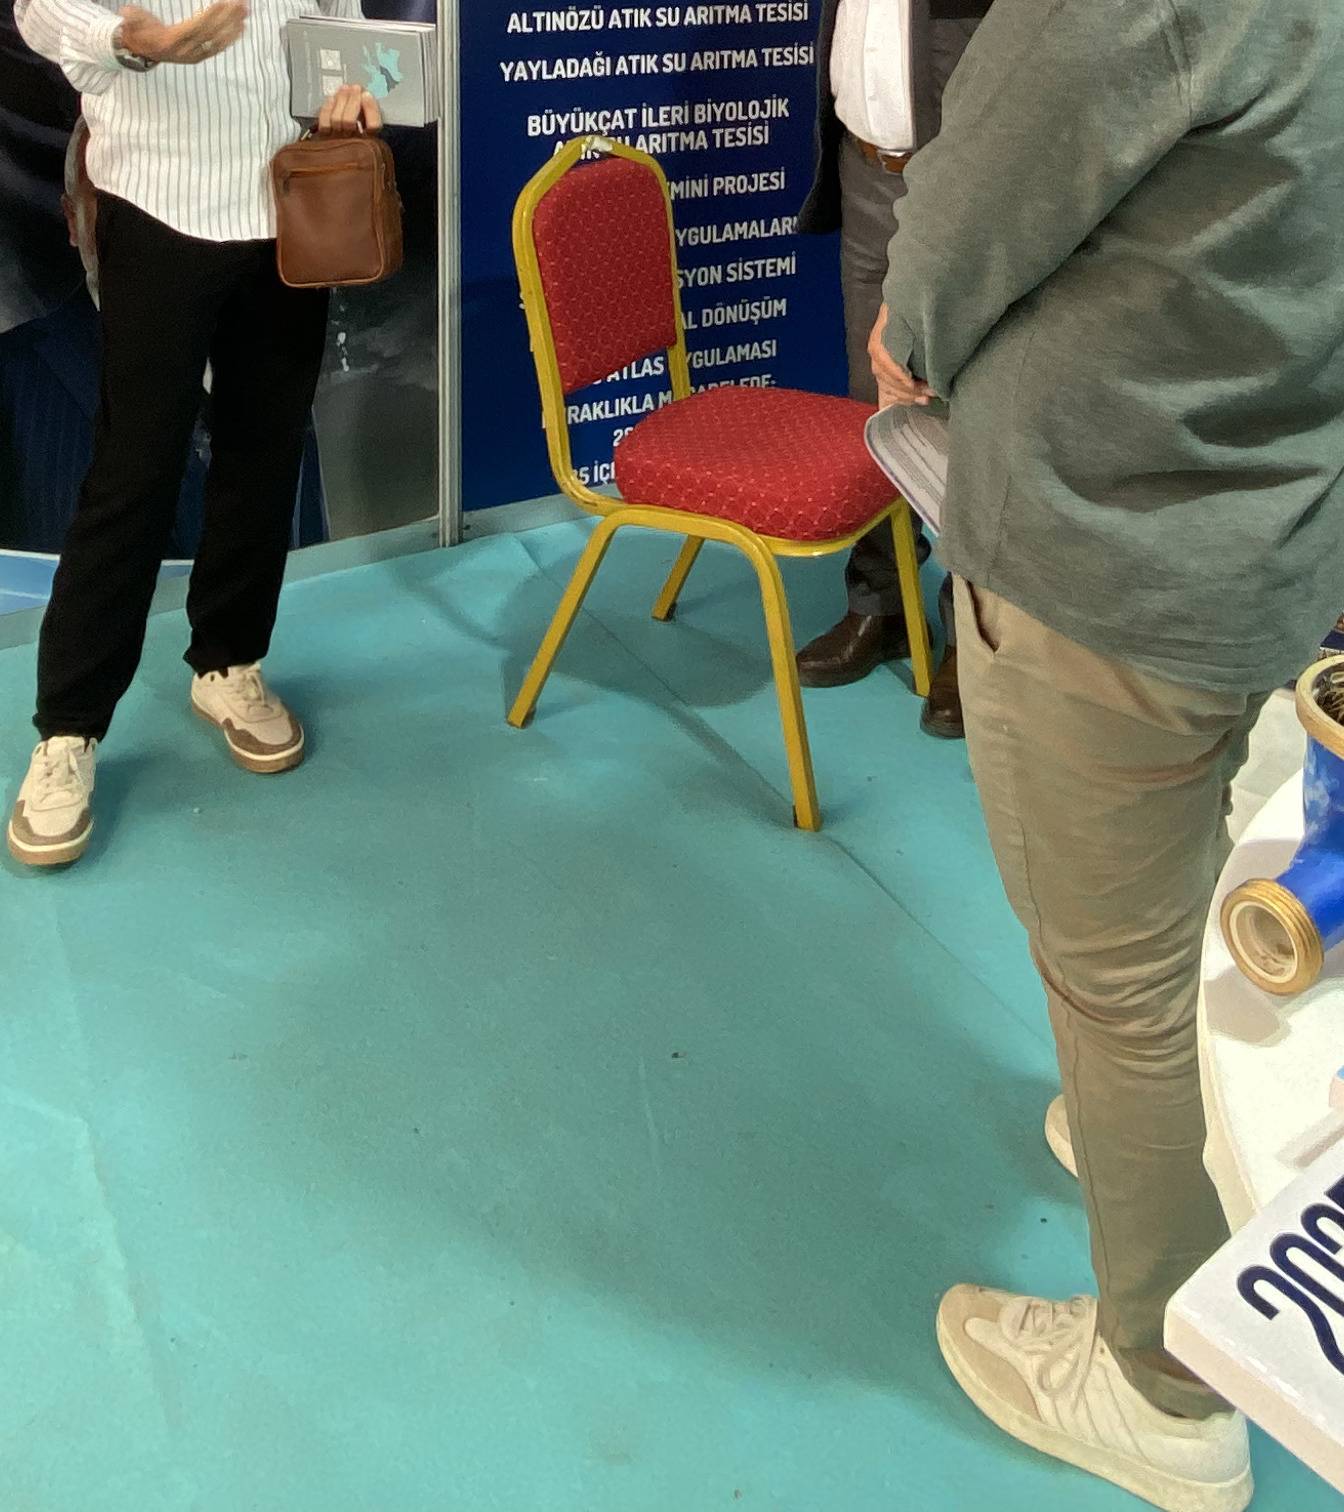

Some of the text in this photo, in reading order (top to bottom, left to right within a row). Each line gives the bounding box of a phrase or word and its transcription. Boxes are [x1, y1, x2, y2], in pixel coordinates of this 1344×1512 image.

[507, 6, 603, 33] ALTINÖZÜ
[608, 8, 651, 30] ATIK
[656, 7, 679, 28] SU
[684, 2, 751, 25] ARITMA
[500, 44, 814, 82] YAYLADAĞI ATIK SU ARITMA TESİSİ
[527, 97, 789, 136] BÜYÜKÇAT İLERİ BİYOLOJİK
[636, 132, 708, 155] ARITMA
[712, 125, 769, 148] TESİSİ
[667, 166, 785, 200] MİNİ PROJESİ
[677, 250, 796, 289] SYON SİSTEMİ
[702, 295, 787, 327] DÖNÜŞÜM
